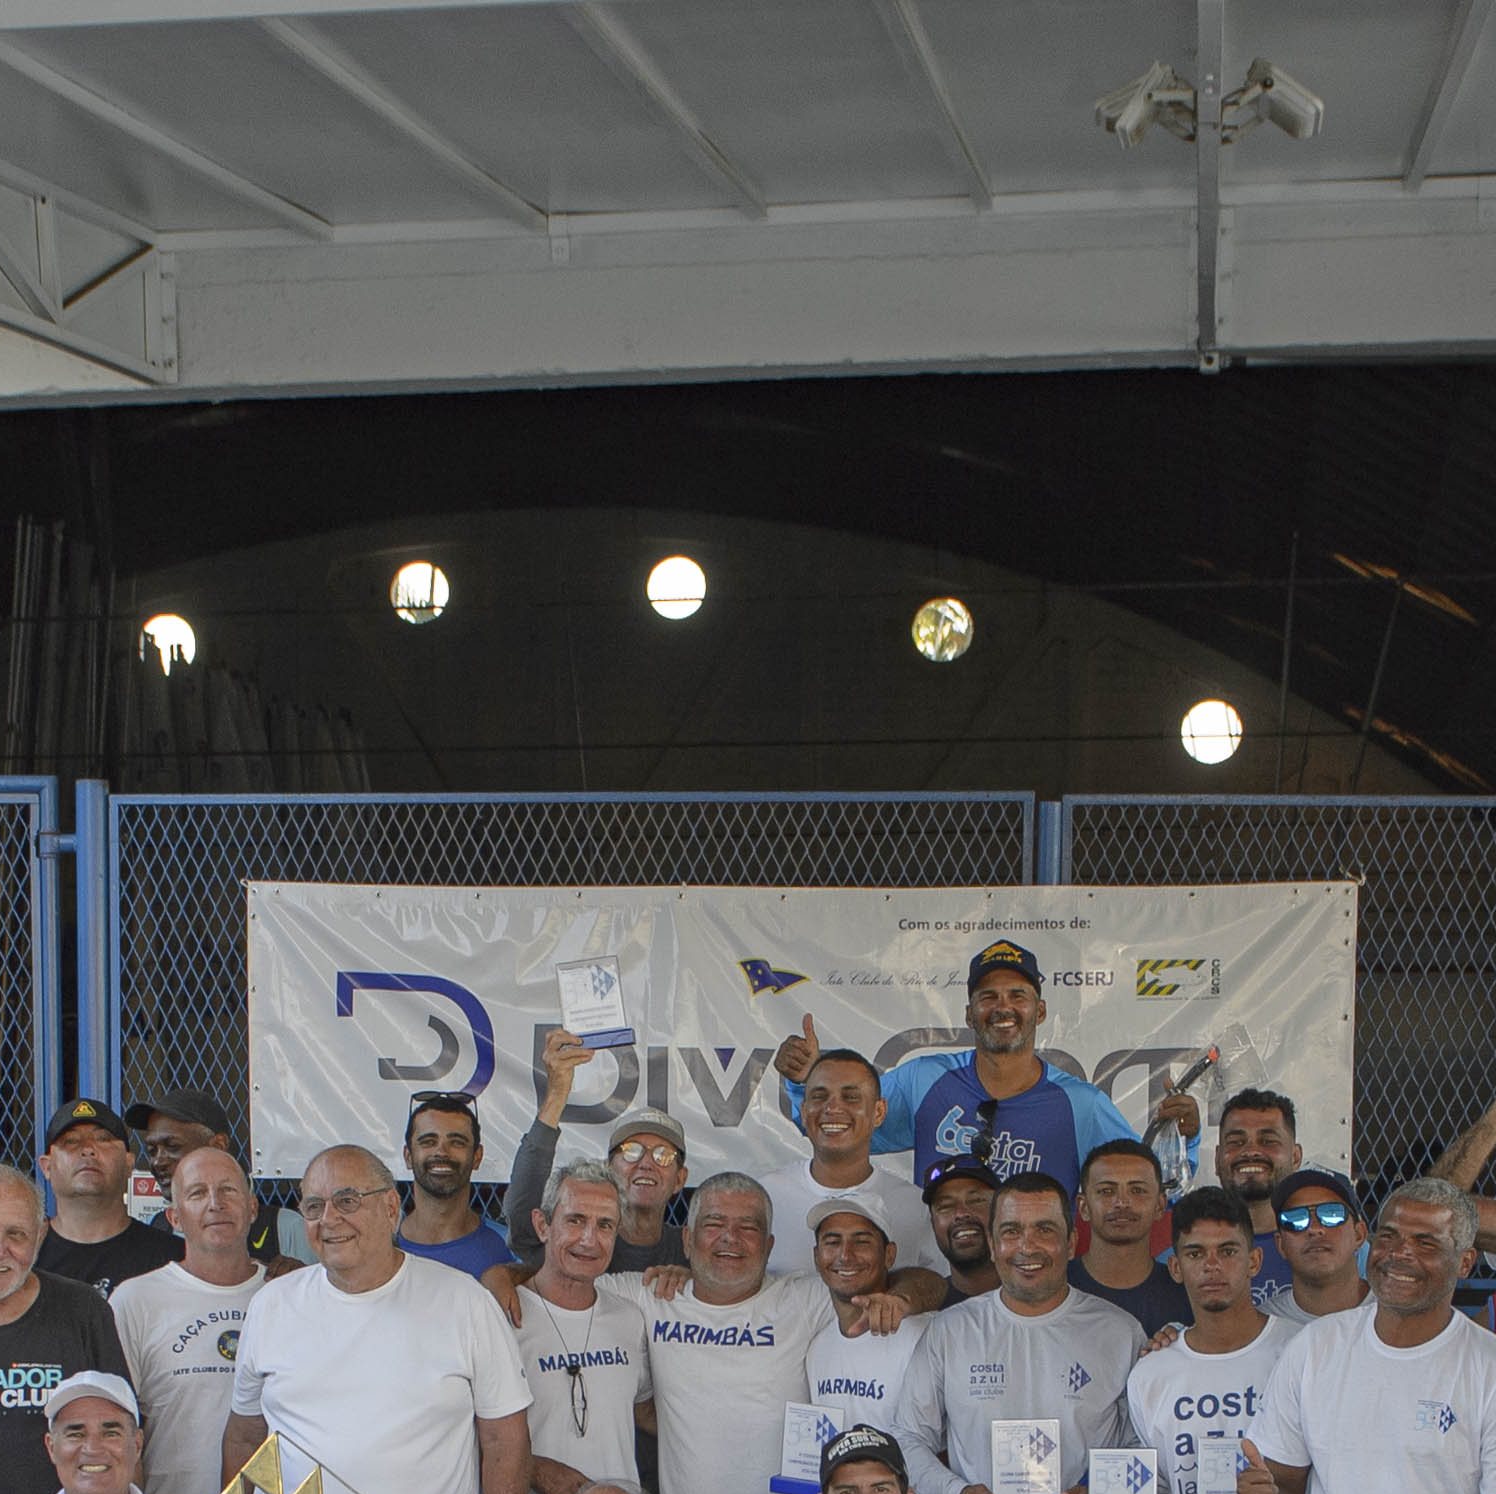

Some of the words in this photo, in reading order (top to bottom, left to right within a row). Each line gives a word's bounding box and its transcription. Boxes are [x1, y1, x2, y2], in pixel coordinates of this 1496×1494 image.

[898, 917, 929, 931] Com
[934, 921, 950, 931] os
[954, 917, 1065, 933] agradecimentos
[1070, 917, 1091, 930] de:
[1053, 971, 1113, 986] FCSERJ
[172, 1319, 208, 1354] CAÇA
[653, 1320, 775, 1347] MARIMBÁS
[192, 1366, 218, 1374] CLUBE
[538, 1346, 630, 1373] MARIMBÁS
[970, 1363, 1004, 1373] costa
[817, 1378, 885, 1400] MARIMBÁS
[1174, 1385, 1264, 1420] cost
